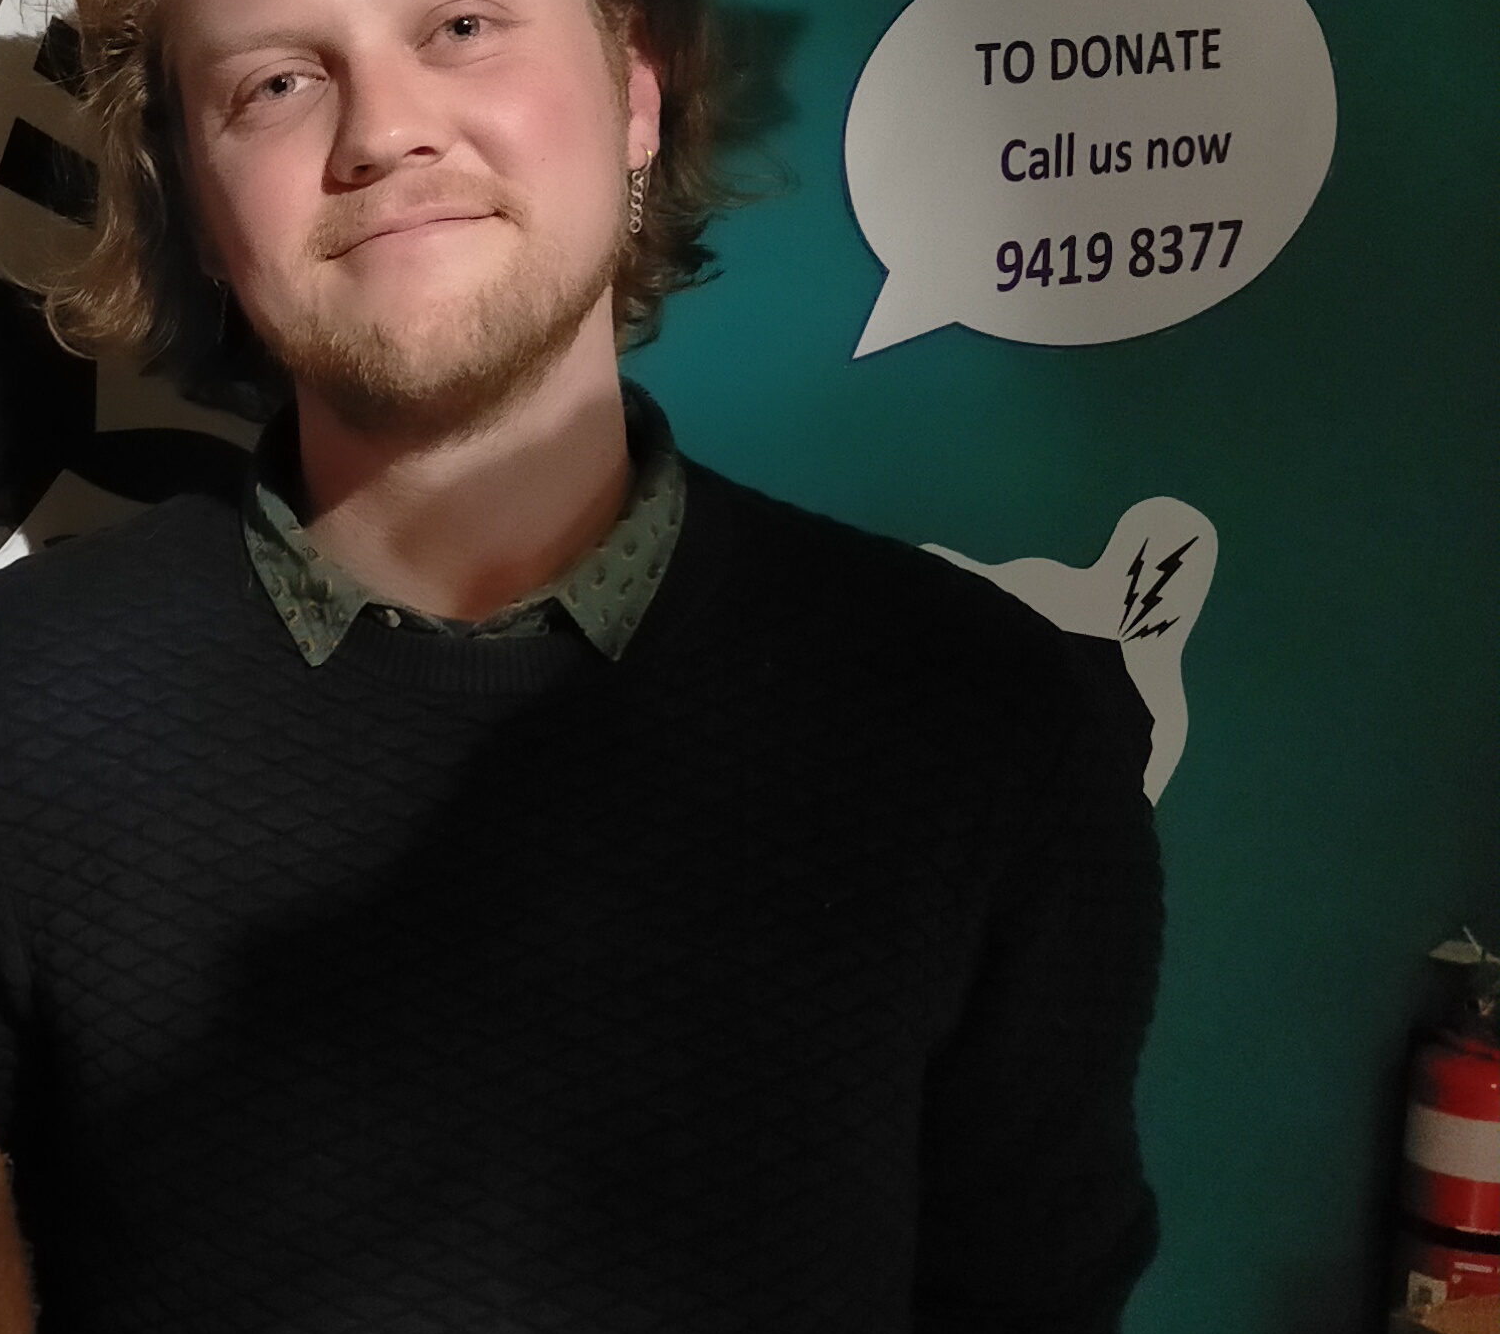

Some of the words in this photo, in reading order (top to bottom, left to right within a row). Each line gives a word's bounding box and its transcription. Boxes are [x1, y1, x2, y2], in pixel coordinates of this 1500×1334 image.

[974, 40, 1036, 86] TO
[1050, 27, 1222, 81] DONATE
[1000, 131, 1075, 183] Call
[1089, 140, 1132, 176] us
[1146, 131, 1232, 171] now
[996, 231, 1113, 293] 9419
[1128, 219, 1243, 278] 8377
